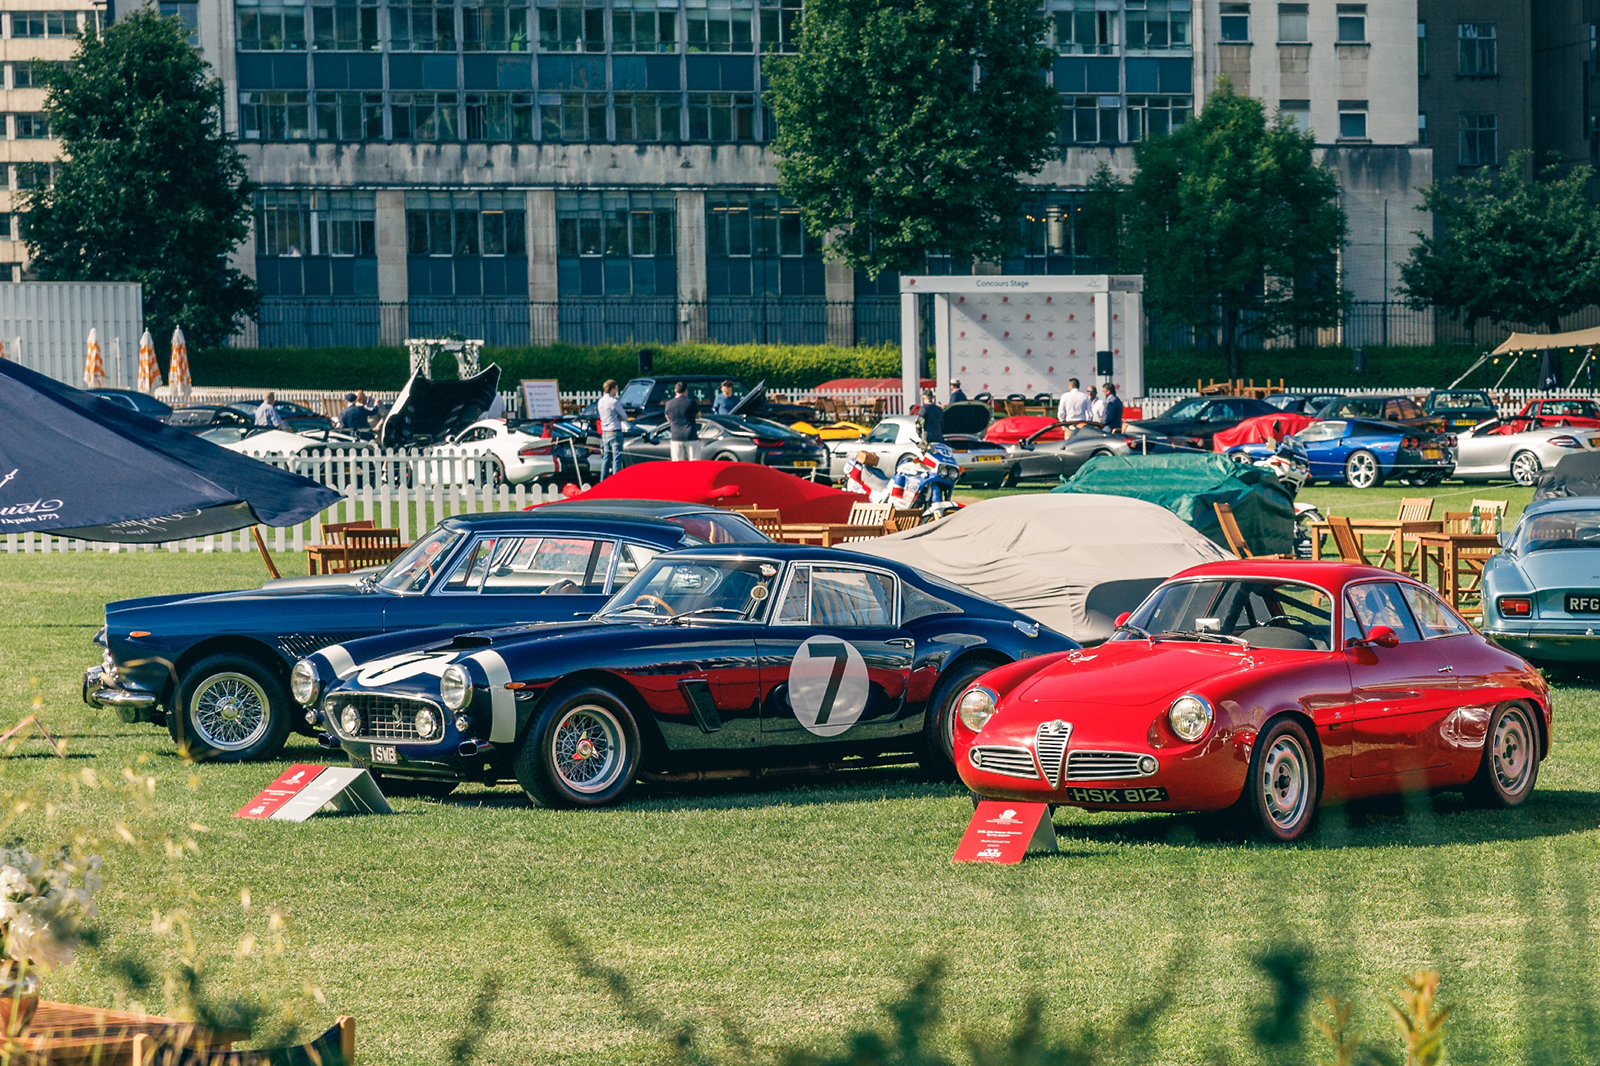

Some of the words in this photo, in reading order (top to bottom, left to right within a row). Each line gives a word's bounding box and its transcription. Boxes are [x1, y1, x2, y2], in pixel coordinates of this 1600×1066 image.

[976, 280, 1009, 288] Concours
[1010, 280, 1029, 289] Stage
[1570, 597, 1600, 611] RFG
[806, 643, 849, 725] 7
[1073, 788, 1120, 803] HSK
[1124, 788, 1162, 802] 812
